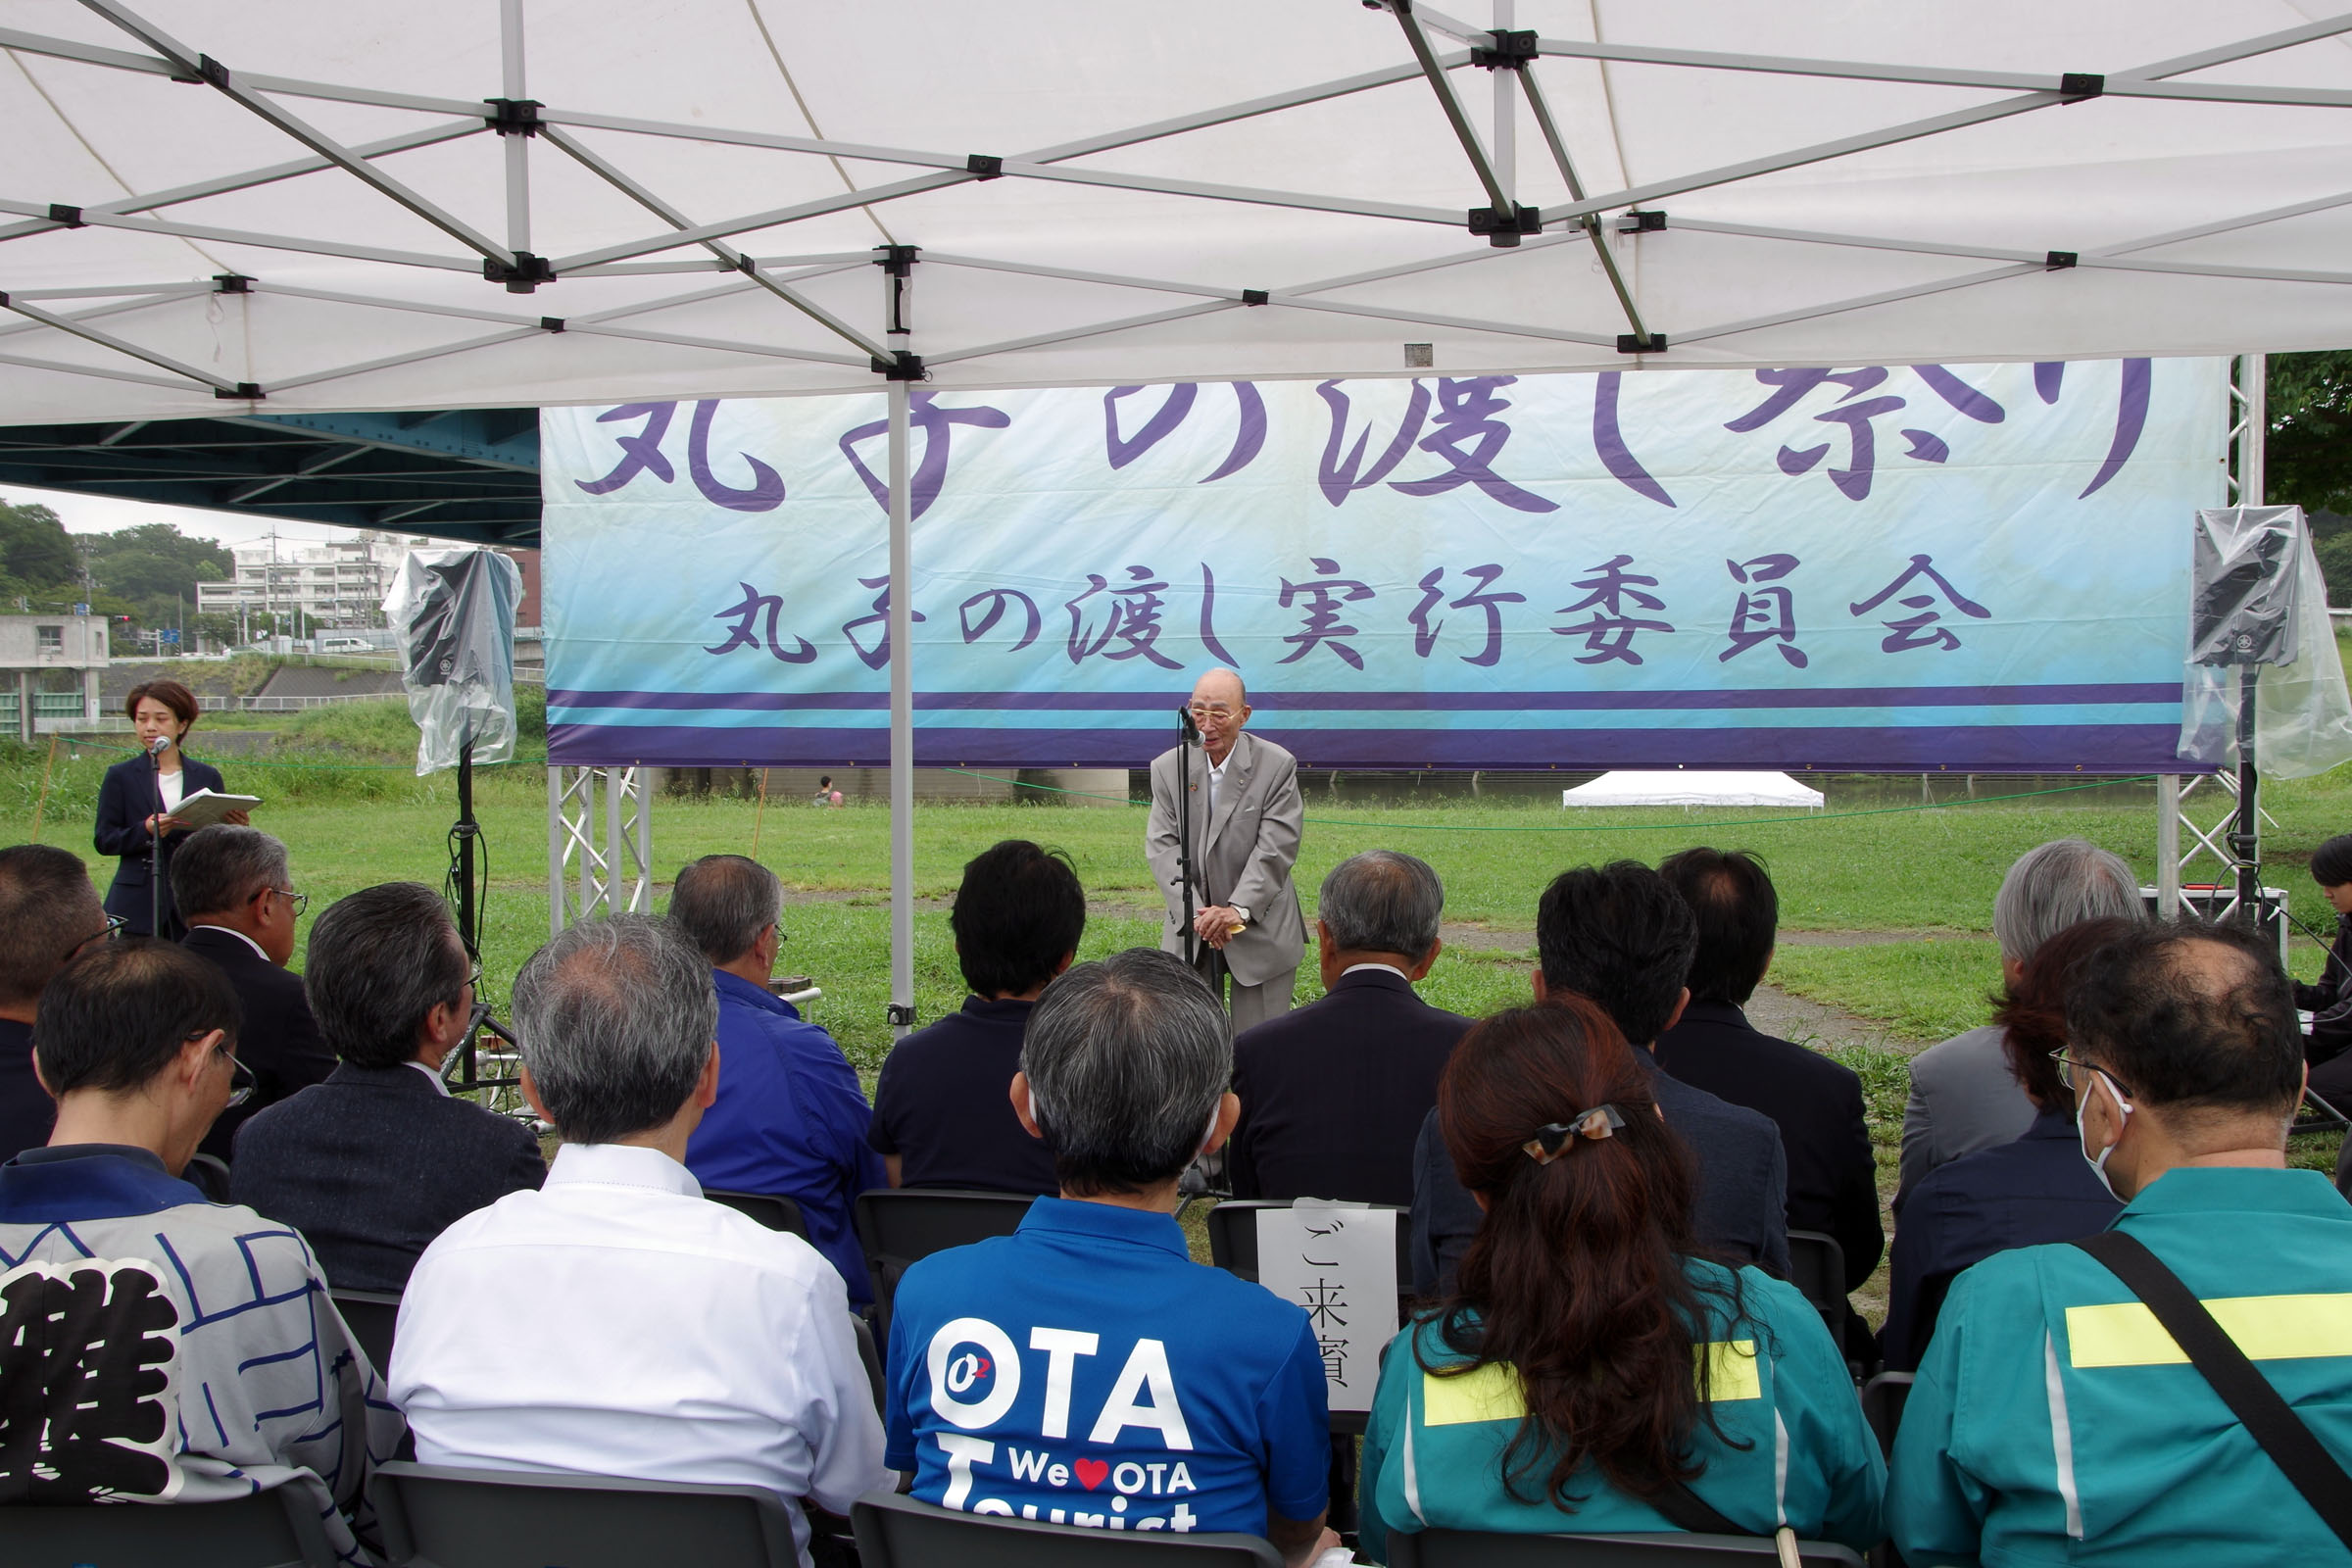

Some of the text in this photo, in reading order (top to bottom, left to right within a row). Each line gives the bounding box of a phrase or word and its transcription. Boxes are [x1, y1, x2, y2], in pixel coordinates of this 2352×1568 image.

[703, 553, 1992, 671] 丸子の渡し実行委員会
[927, 1317, 1195, 1450] OTA
[1008, 1446, 1198, 1494] We OTA
